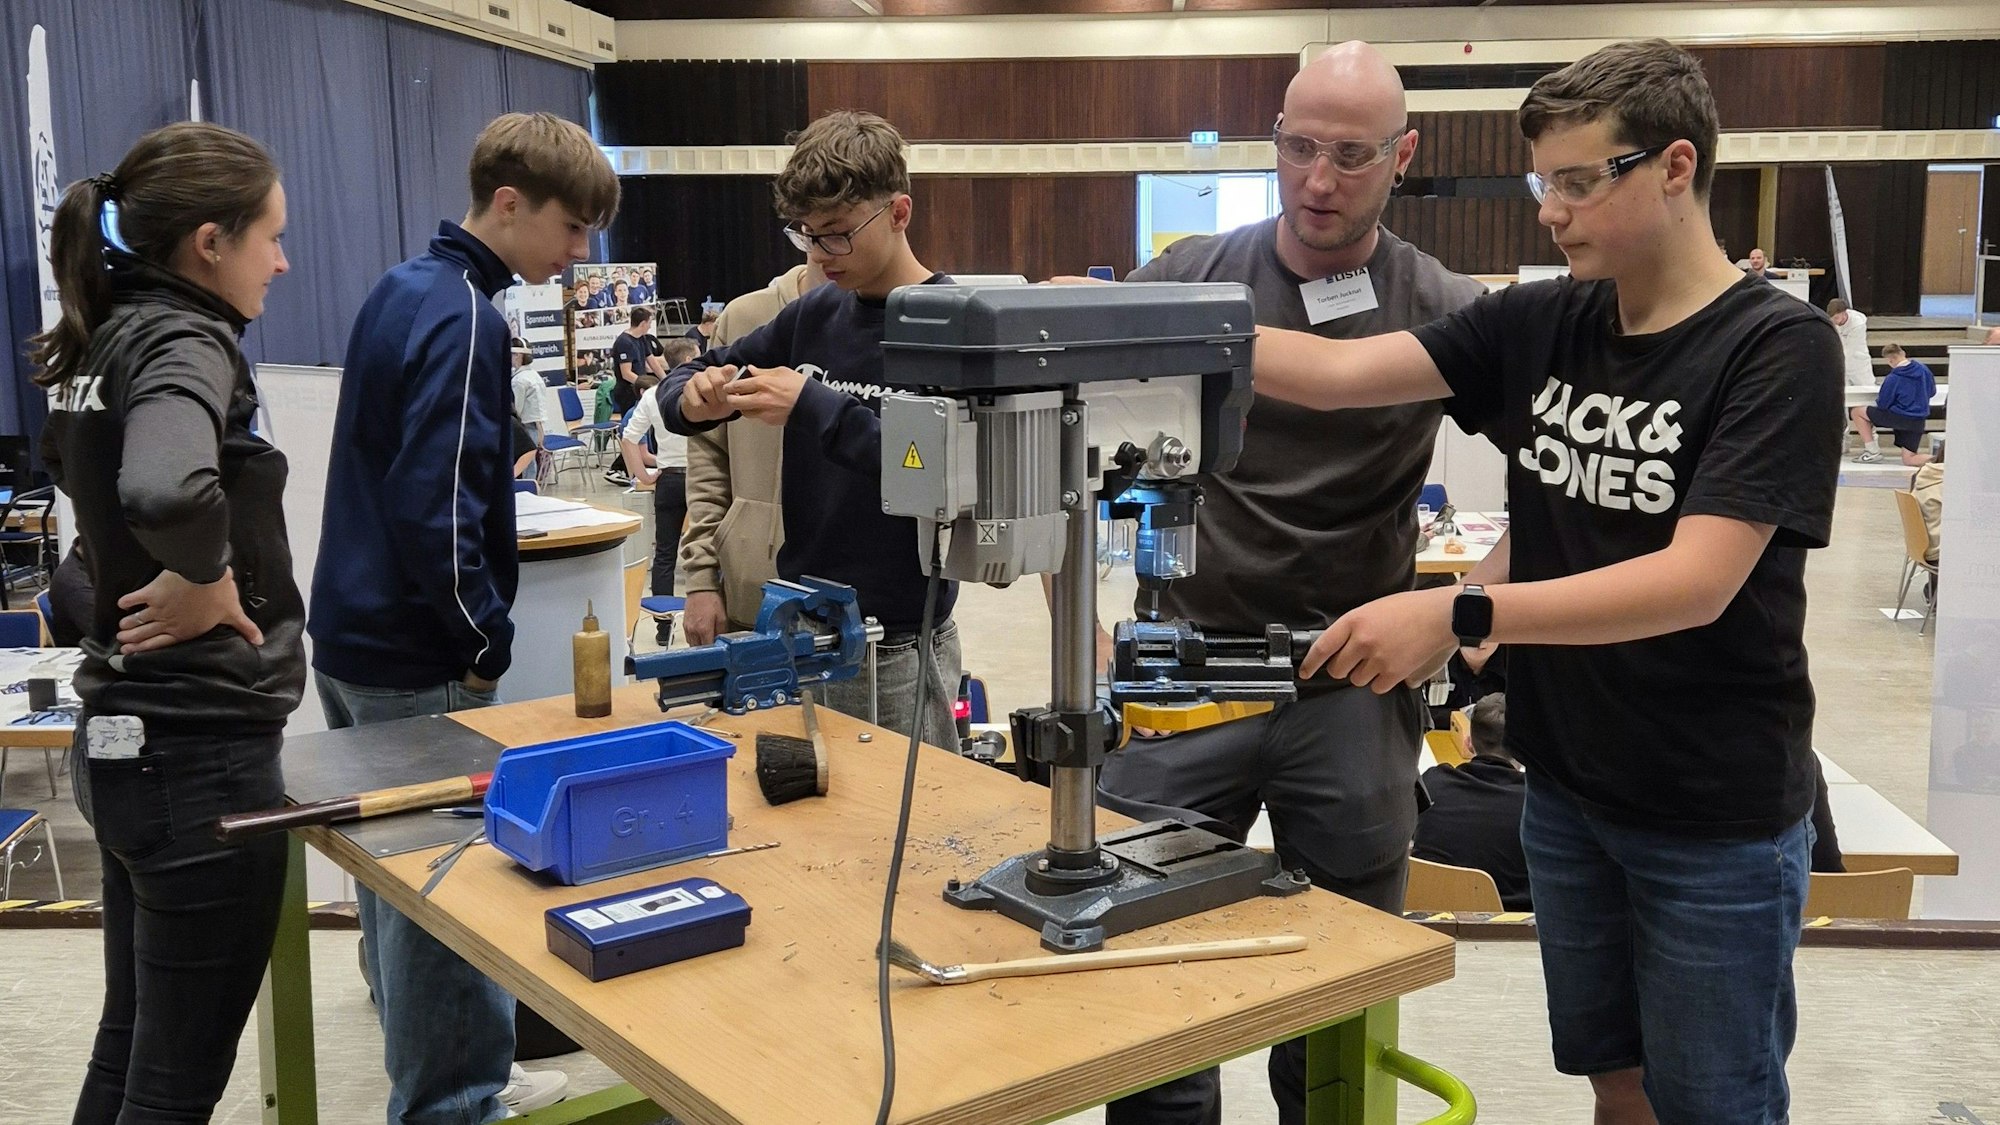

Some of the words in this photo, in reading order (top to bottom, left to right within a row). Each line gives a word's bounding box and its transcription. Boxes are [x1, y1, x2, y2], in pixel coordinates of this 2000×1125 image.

[1335, 268, 1367, 281] LISTA
[1317, 294, 1338, 303] Torben
[526, 313, 556, 325] Spannend.
